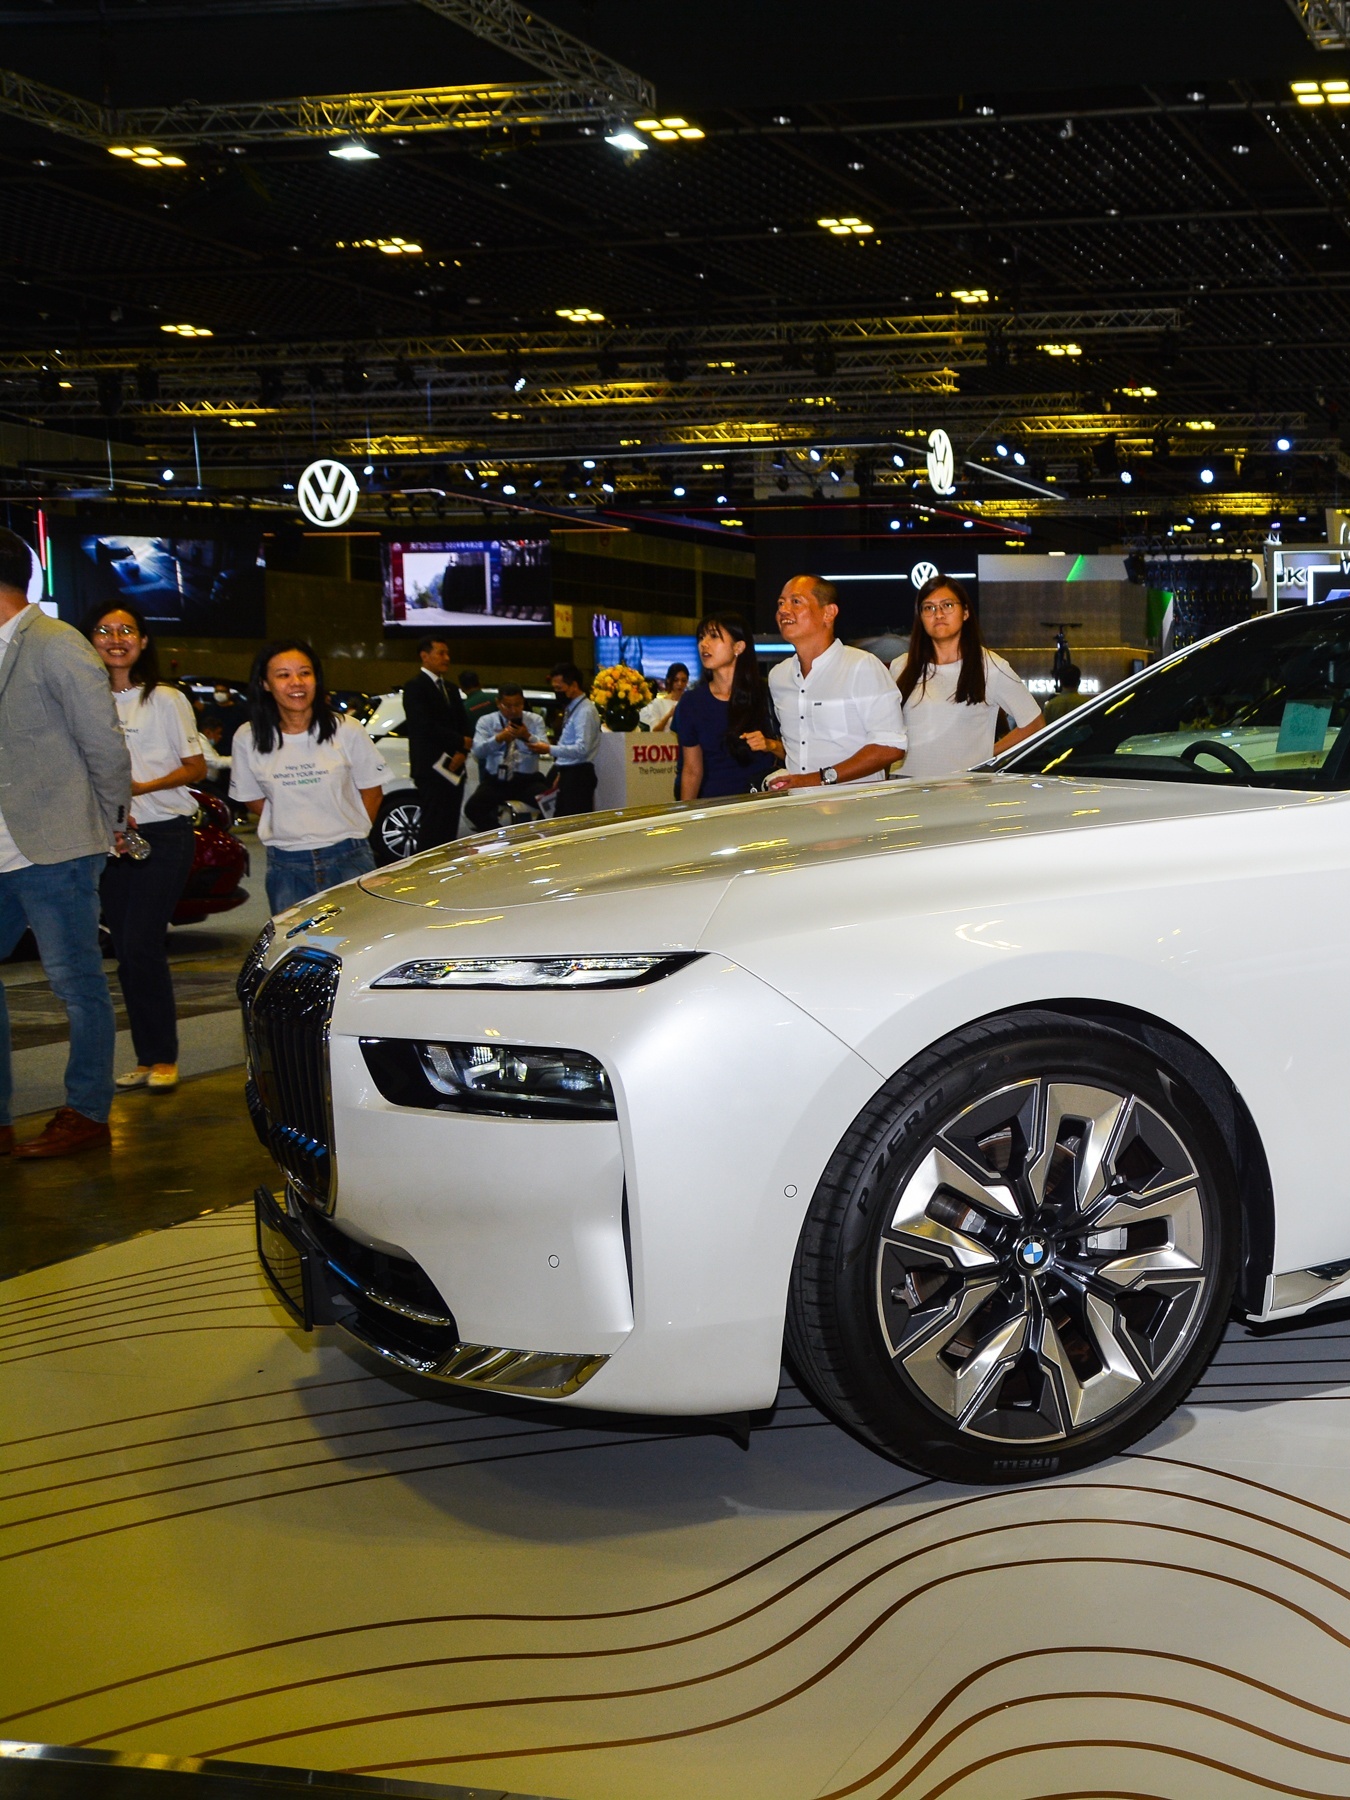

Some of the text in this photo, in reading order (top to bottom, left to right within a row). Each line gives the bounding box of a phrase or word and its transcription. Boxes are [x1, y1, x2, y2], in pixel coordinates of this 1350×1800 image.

[632, 745, 679, 762] HON
[639, 767, 649, 775] The
[649, 766, 666, 774] Power
[857, 1087, 945, 1217] P ZERO
[991, 1456, 1060, 1473] PIRELLI
